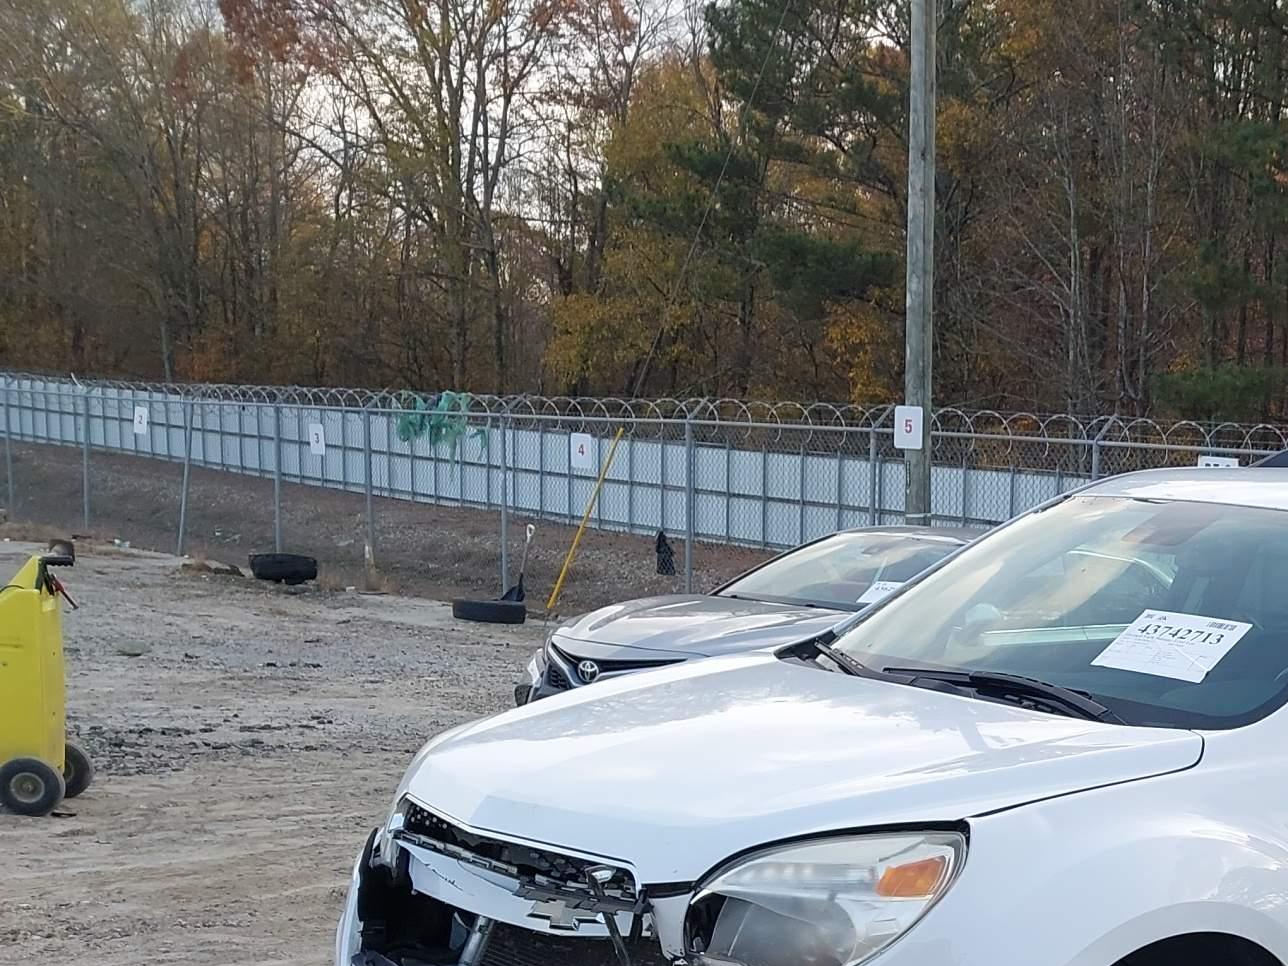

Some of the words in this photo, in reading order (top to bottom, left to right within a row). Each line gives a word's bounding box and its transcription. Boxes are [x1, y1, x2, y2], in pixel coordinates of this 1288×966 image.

[905, 419, 913, 434] 5
[314, 432, 320, 444] 3
[578, 444, 585, 457] 4
[1138, 623, 1225, 646] 43742713
